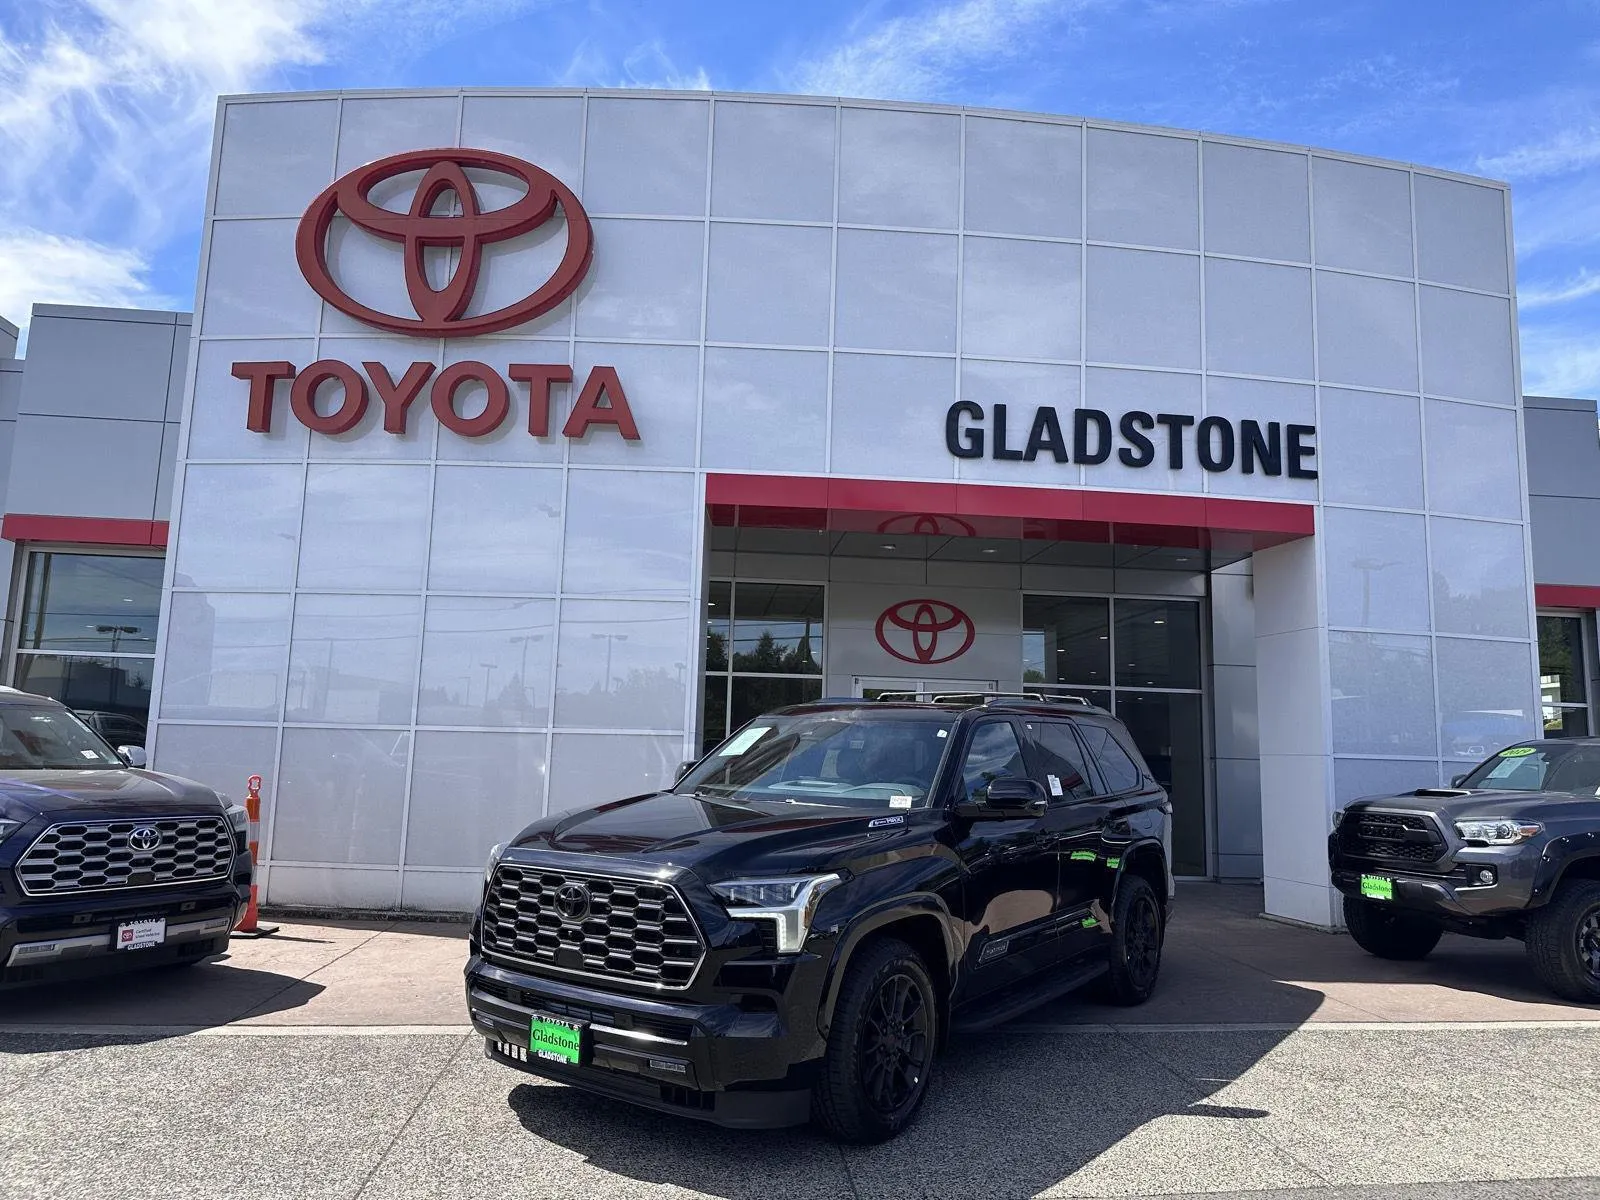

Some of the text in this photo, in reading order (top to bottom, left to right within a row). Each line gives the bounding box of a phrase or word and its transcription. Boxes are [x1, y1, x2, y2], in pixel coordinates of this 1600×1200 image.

[231, 359, 641, 441] TOYOTA
[945, 400, 1319, 480] GLADSTONE
[127, 941, 155, 951] GLADSTONE
[542, 1016, 570, 1028] TOYOTA
[532, 1028, 580, 1051] Gladstone
[537, 1049, 568, 1064] GLADSTONE
